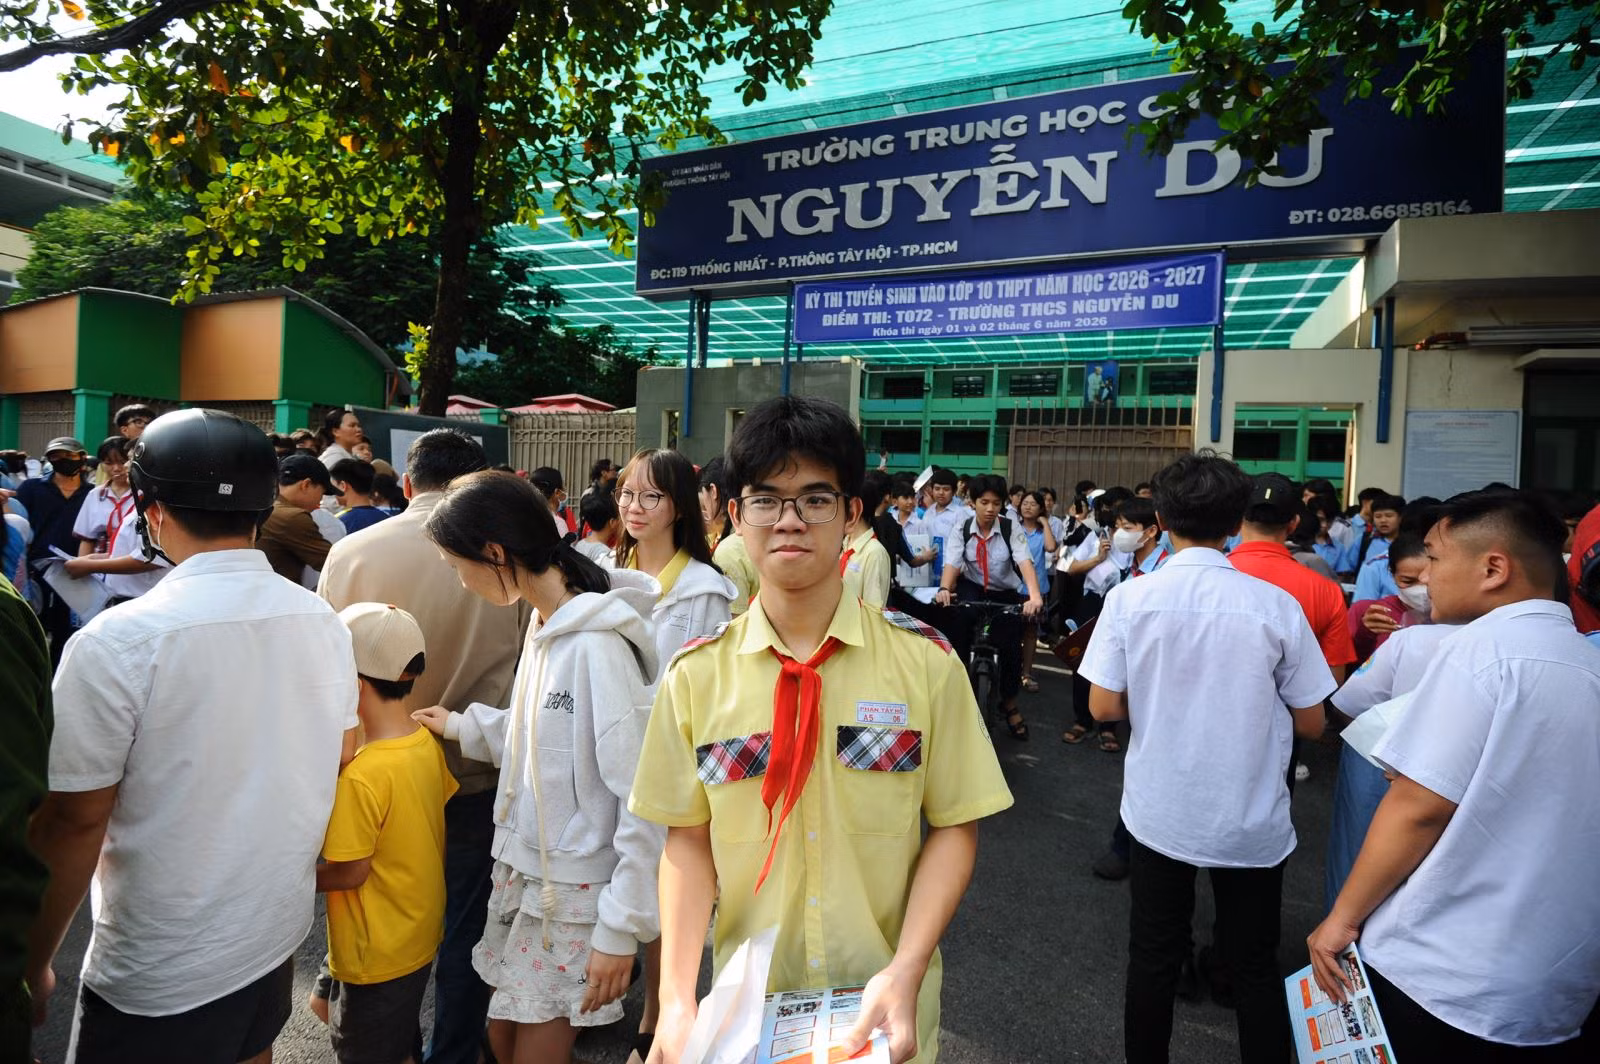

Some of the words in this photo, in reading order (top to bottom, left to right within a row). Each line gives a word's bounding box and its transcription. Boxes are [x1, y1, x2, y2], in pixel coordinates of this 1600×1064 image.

[763, 134, 894, 171] TRƯỜNG
[905, 115, 1027, 151] TRUNG
[1040, 100, 1126, 134] HỌC
[726, 143, 1118, 243] NGUYỄN
[1288, 209, 1323, 225] ĐT:
[1328, 200, 1472, 222] 028.66858164
[690, 259, 731, 276] THỐNG
[734, 254, 768, 272] NHẤT
[778, 251, 835, 268] P.THÔNG
[837, 247, 864, 263] TÂY
[866, 244, 891, 263] HỘI
[900, 240, 958, 257] TP.HCM
[805, 290, 821, 309] KỲ
[823, 292, 842, 308] THI
[846, 283, 883, 307] TUYỂN
[886, 287, 916, 305] SINH
[920, 283, 946, 303] VÀO
[949, 280, 974, 301] LỚP
[977, 281, 993, 300] 10
[997, 278, 1032, 298] THPT
[1036, 274, 1068, 296] NĂM
[1072, 273, 1104, 296] HỌC
[1108, 269, 1149, 291] 2026
[1164, 265, 1206, 287] 2027
[822, 309, 858, 326] ĐIỂM
[862, 311, 891, 325] THI:
[948, 304, 1015, 321] TRƯỜNG
[1020, 301, 1067, 317] THCS
[1072, 292, 1145, 314] NGUYỄN
[1152, 293, 1179, 309] DU
[873, 327, 898, 337] Khóa
[902, 326, 915, 335] thi
[918, 325, 943, 336] ngày
[946, 324, 959, 333] 01
[963, 323, 976, 332] và
[979, 322, 994, 332] 02
[997, 321, 1030, 332] tháng
[1034, 320, 1042, 329] 6
[1046, 320, 1071, 328] năm
[1075, 317, 1107, 327] 2026
